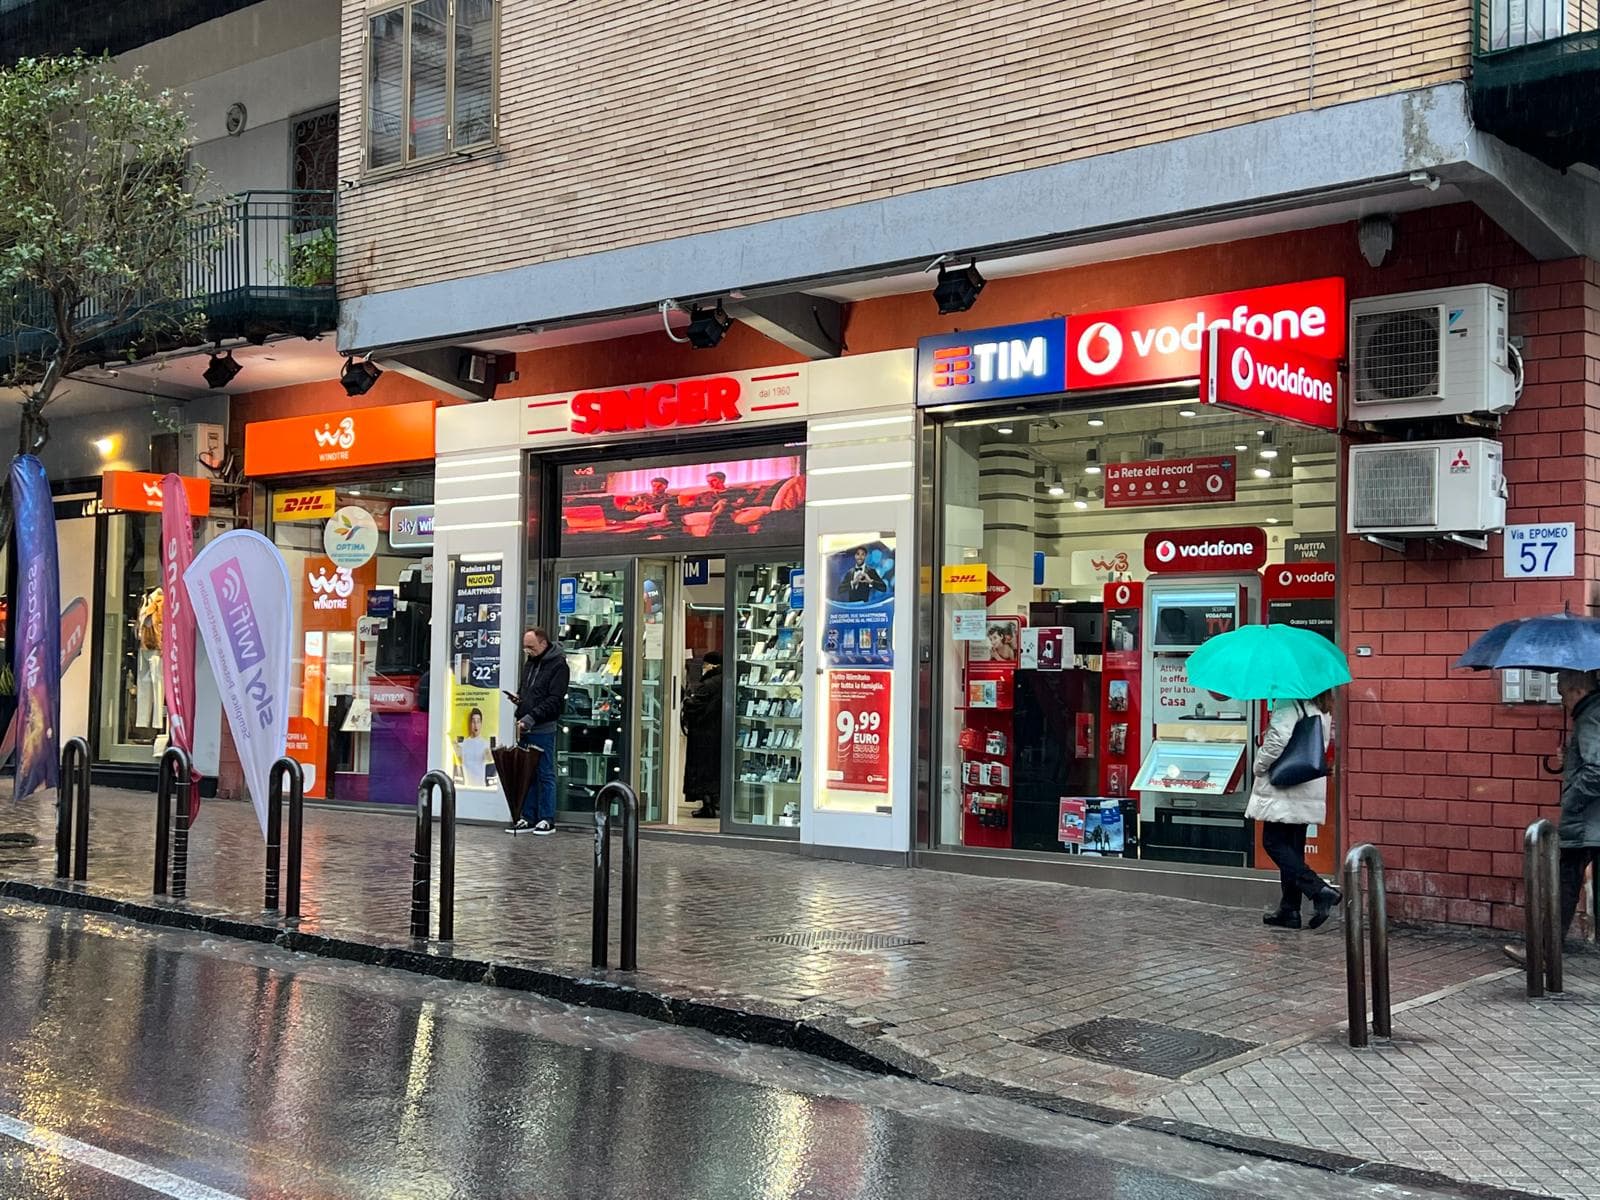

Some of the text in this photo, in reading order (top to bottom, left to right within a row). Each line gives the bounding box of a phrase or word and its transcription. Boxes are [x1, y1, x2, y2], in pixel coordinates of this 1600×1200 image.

[975, 336, 1046, 383] TIM
[1255, 362, 1333, 404] vodafone
[571, 376, 742, 434] SINGER
[319, 451, 349, 462] WINDTRE
[1108, 469, 1120, 479] La
[1121, 466, 1143, 478] Rete
[1161, 463, 1194, 475] record
[284, 496, 324, 512] DHL
[398, 517, 416, 535] sky
[1511, 527, 1568, 540] Via EPOMEO
[1179, 539, 1254, 558] vodafone
[1293, 542, 1326, 551] PARTITA
[1520, 542, 1558, 573] 57
[468, 575, 493, 584] NUOVO
[949, 575, 977, 583] DHL
[648, 590, 659, 598] TIM
[313, 599, 348, 610] WINDTRE
[1205, 618, 1232, 635] TV
[1160, 664, 1183, 673] Attiva
[1160, 675, 1168, 683] le
[1160, 686, 1172, 694] per
[1182, 686, 1196, 694] tua
[1160, 696, 1186, 707] Casa
[836, 710, 880, 744] 9,99
[853, 733, 880, 744] EURO
